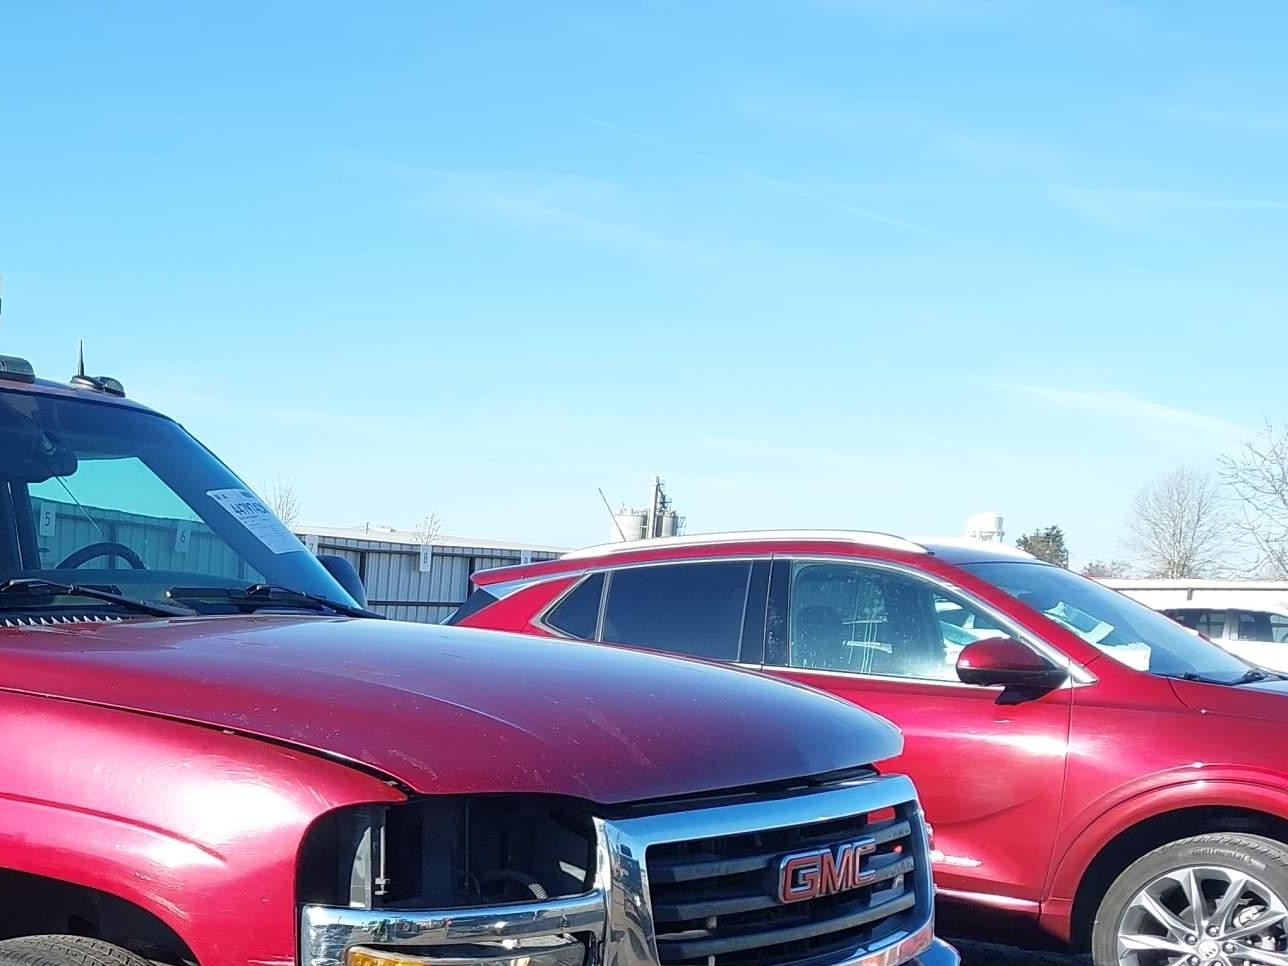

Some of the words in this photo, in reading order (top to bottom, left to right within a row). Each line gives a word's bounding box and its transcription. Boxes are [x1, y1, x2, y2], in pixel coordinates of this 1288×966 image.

[44, 511, 52, 527] 5
[179, 528, 187, 544] 6
[423, 551, 429, 564] 8
[778, 839, 877, 904] GMC
